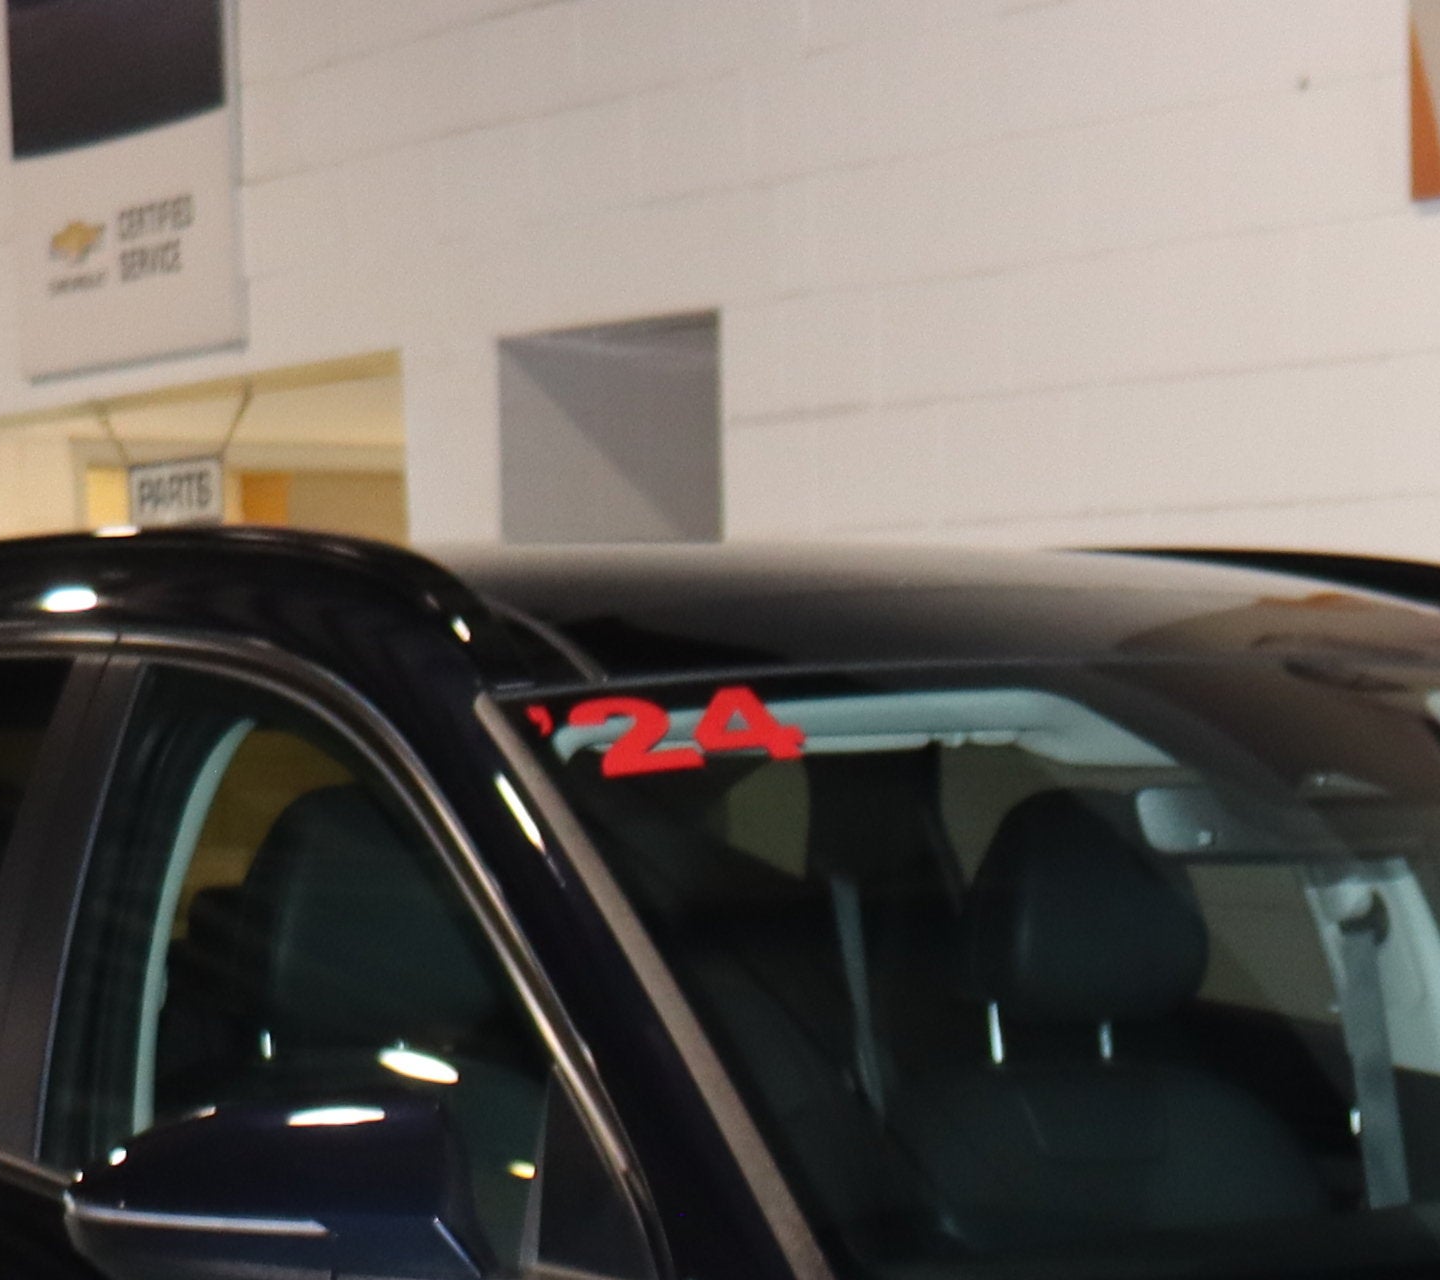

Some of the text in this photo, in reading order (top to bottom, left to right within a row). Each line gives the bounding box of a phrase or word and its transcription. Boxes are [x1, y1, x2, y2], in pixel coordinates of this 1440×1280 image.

[118, 193, 194, 241] CERTIFIED
[119, 238, 183, 283] SERVICE
[138, 469, 212, 512] PARTS
